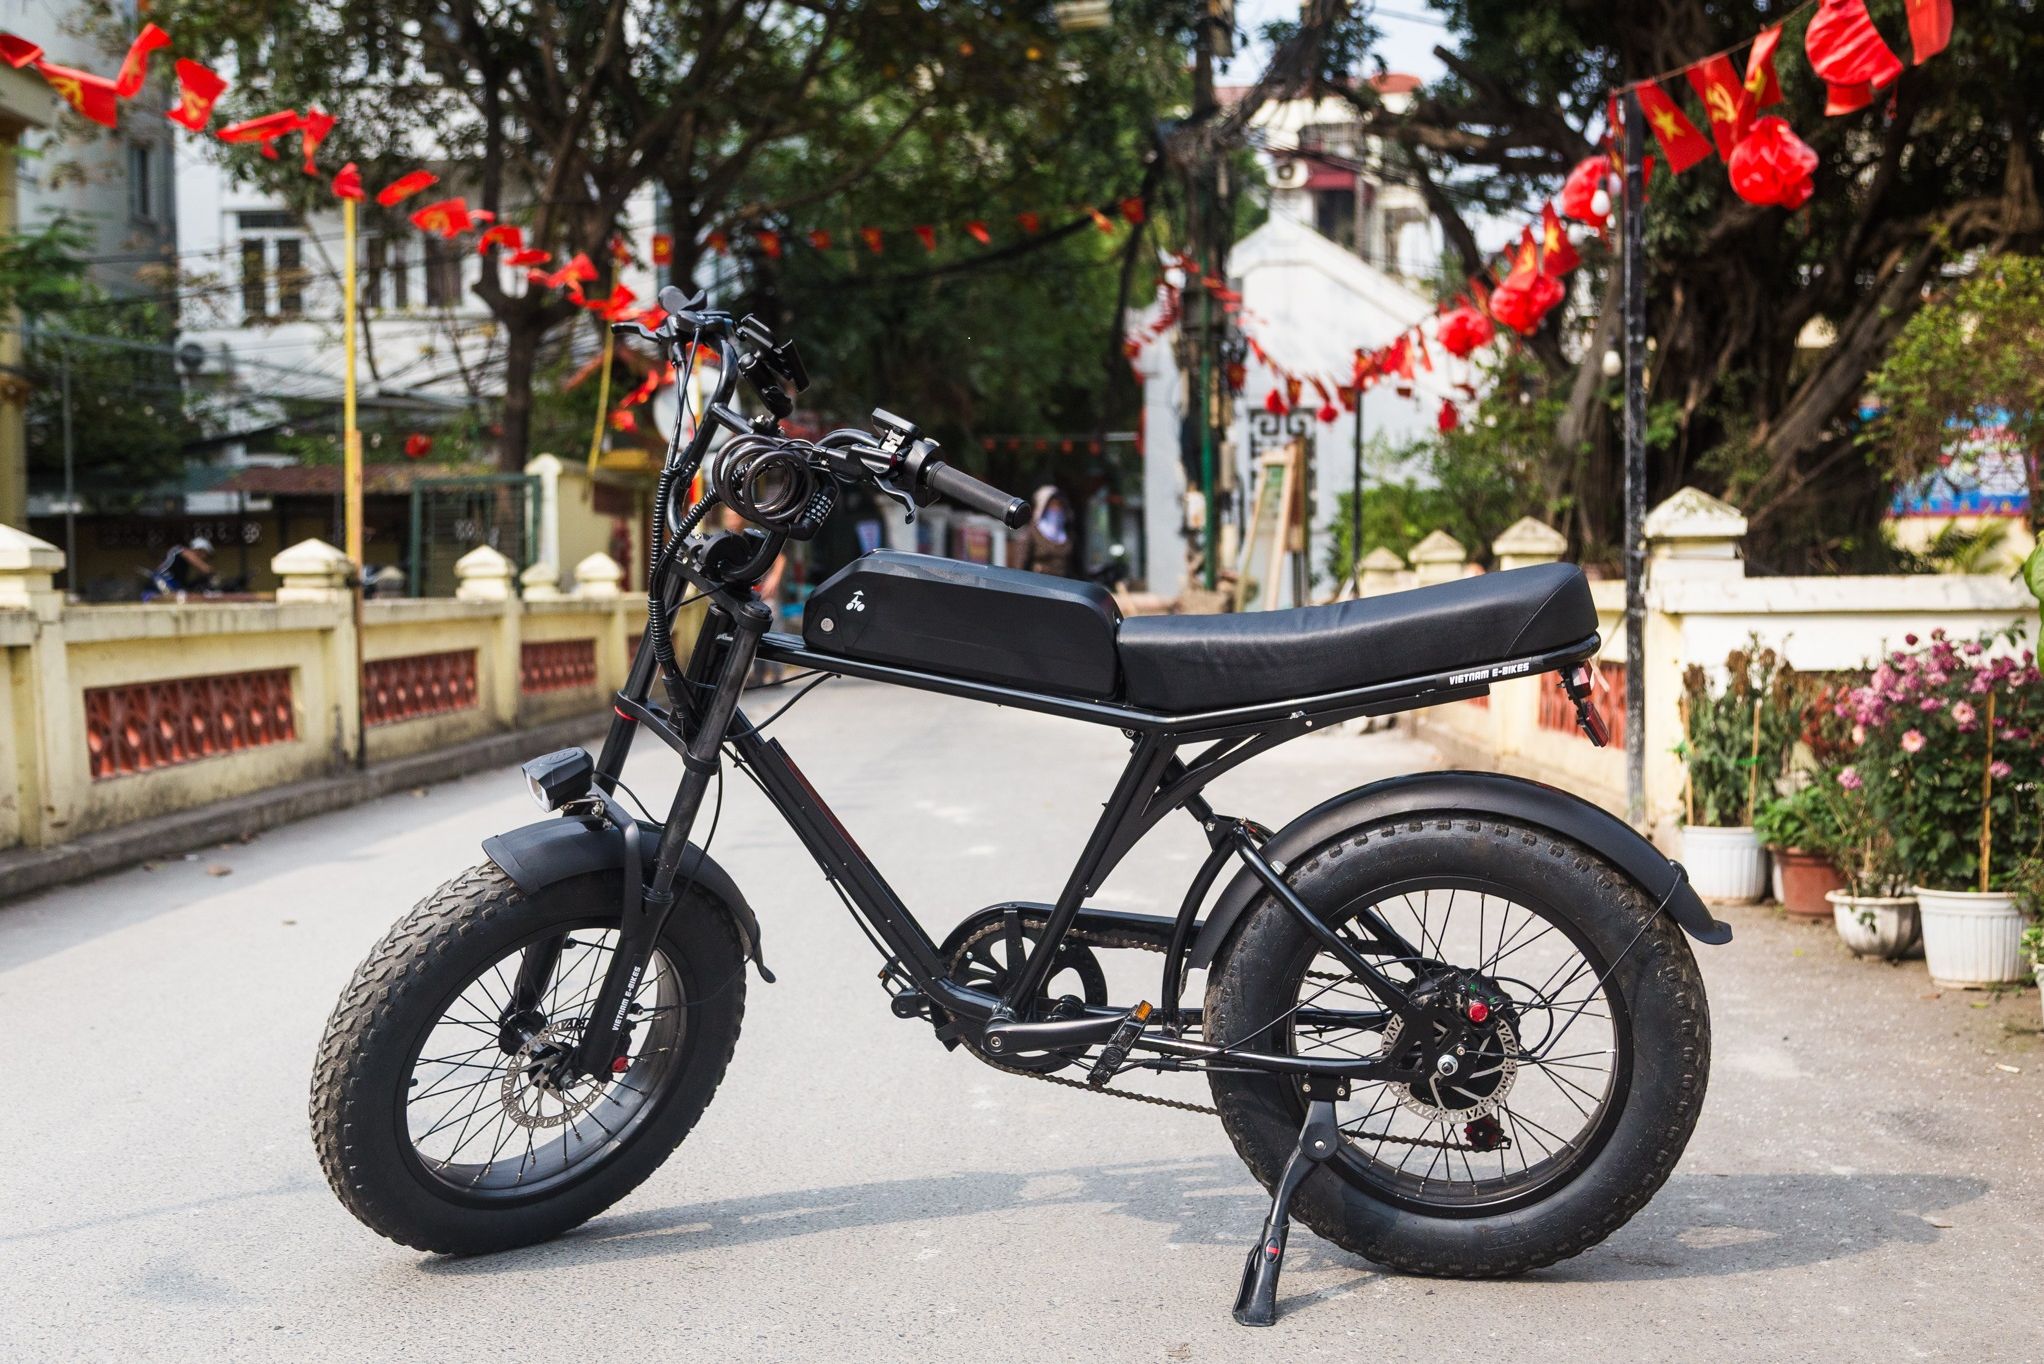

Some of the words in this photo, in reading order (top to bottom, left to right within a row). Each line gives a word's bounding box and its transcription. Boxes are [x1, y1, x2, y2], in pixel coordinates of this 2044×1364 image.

[1449, 670, 1489, 685] VIETNAM
[1492, 663, 1530, 677] E-BIKES
[612, 998, 629, 1031] VIETNAM
[624, 966, 641, 997] E-BIKES
